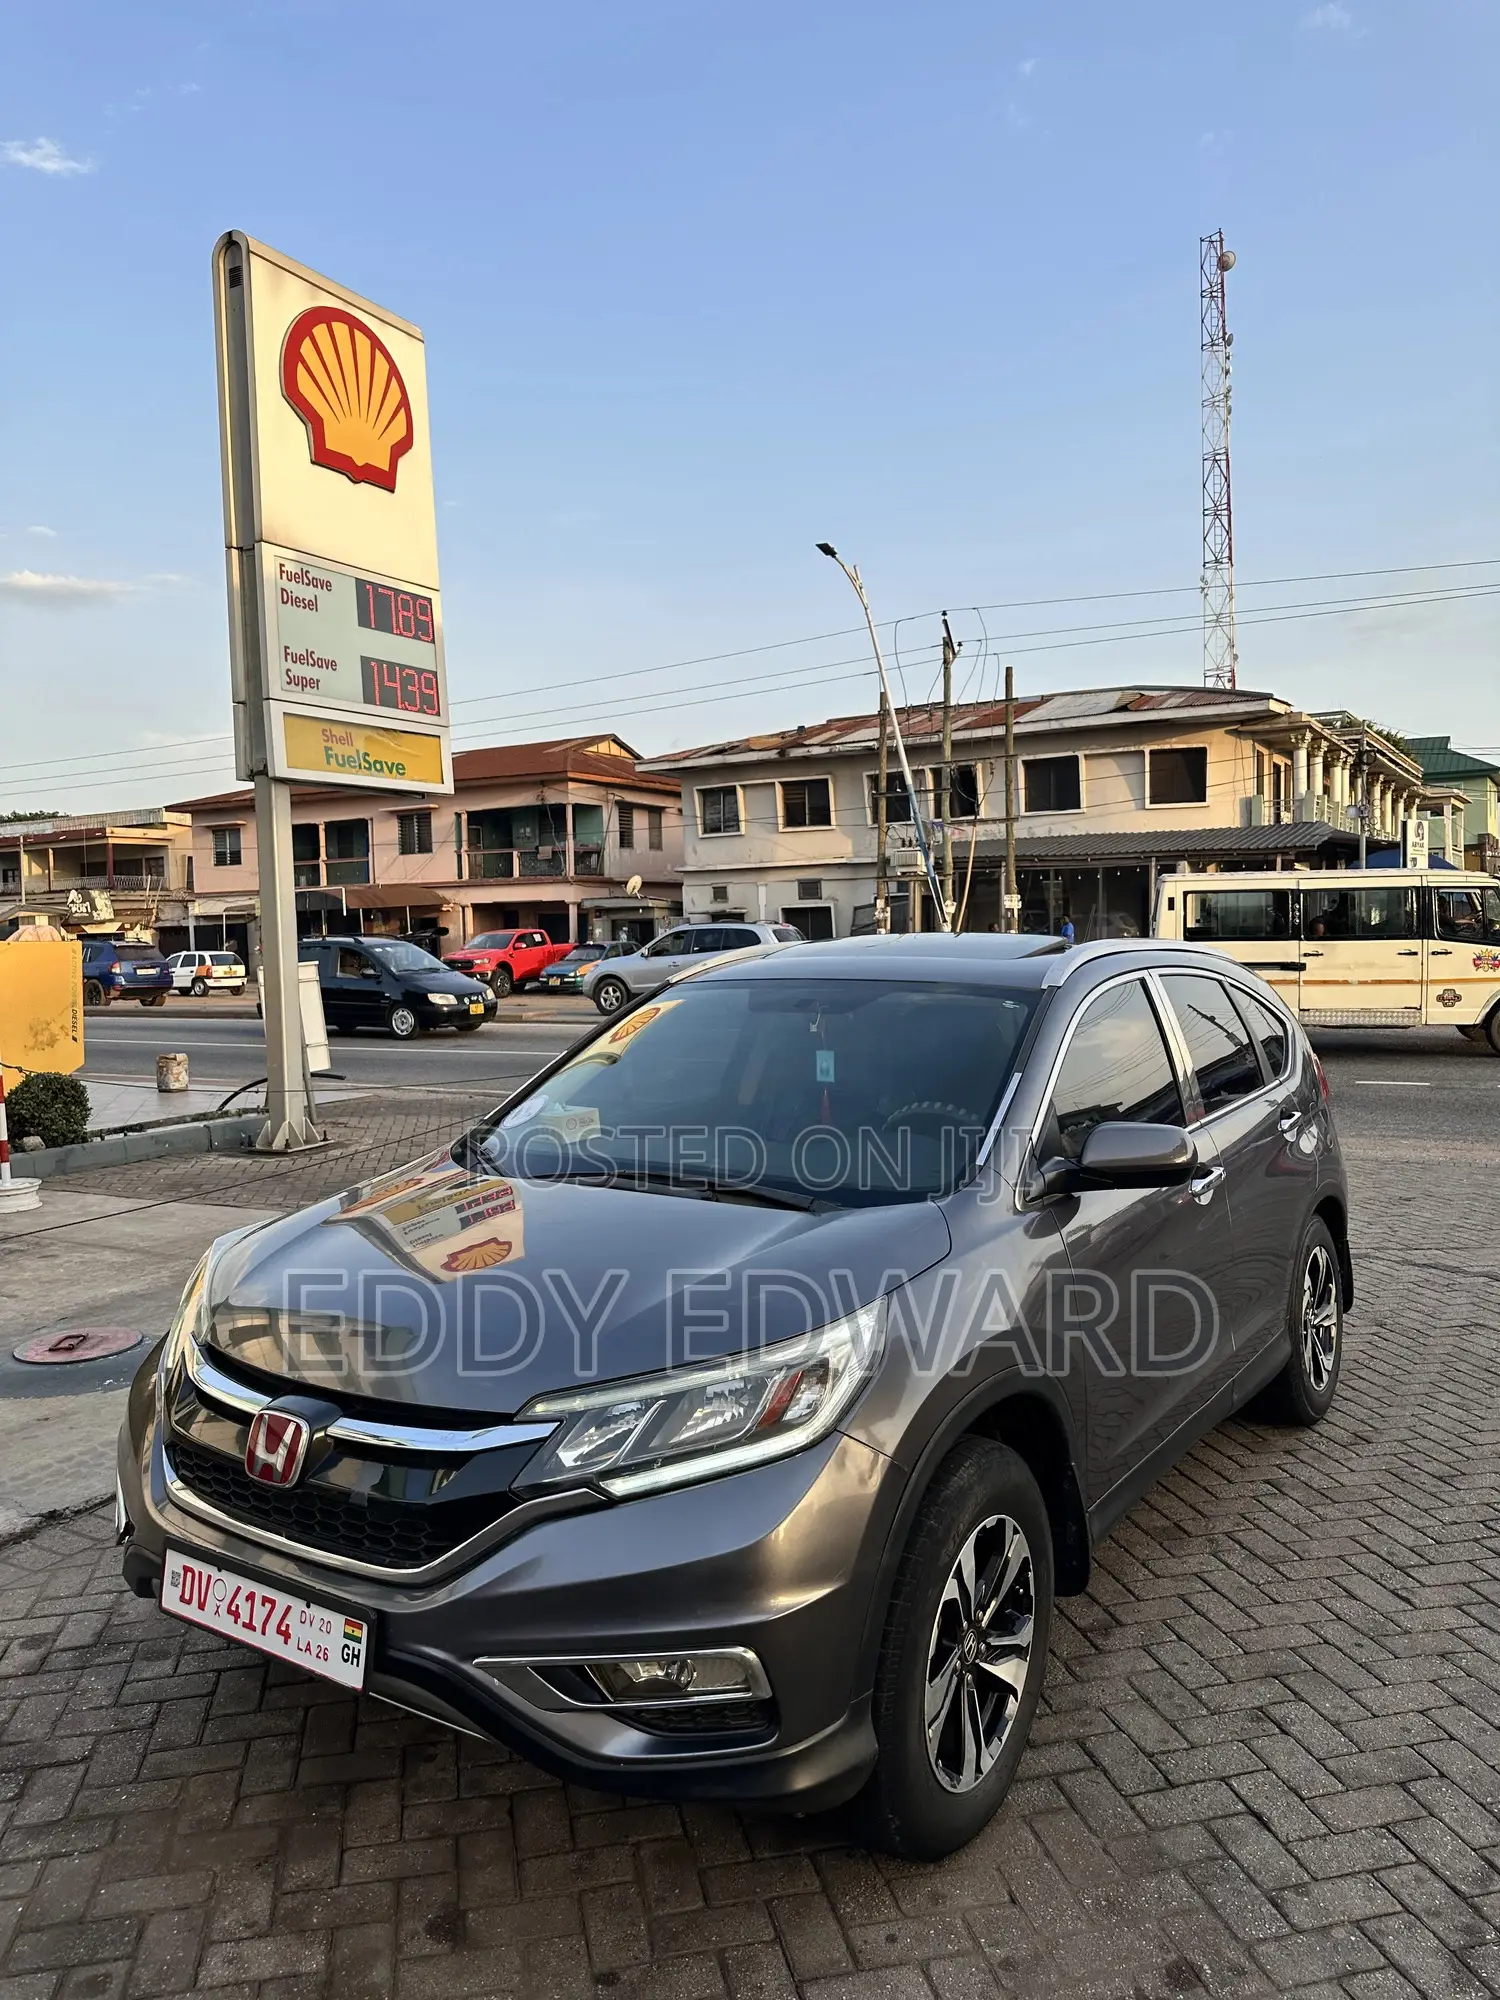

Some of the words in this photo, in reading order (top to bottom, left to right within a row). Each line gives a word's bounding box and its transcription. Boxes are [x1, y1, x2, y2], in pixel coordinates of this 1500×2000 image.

[279, 563, 333, 592] FuelSave
[280, 588, 319, 612] Diesel
[283, 646, 338, 671] FuelSave
[285, 669, 321, 691] Super
[321, 728, 354, 747] Shell
[323, 746, 407, 777] FuelSave
[179, 1564, 213, 1611] DV
[226, 1584, 293, 1646] 4174
[213, 1602, 222, 1617] X
[299, 1609, 317, 1628] DV
[318, 1617, 333, 1635] 20
[296, 1636, 313, 1656] LA
[315, 1644, 330, 1662] 26
[341, 1643, 362, 1668] GH
